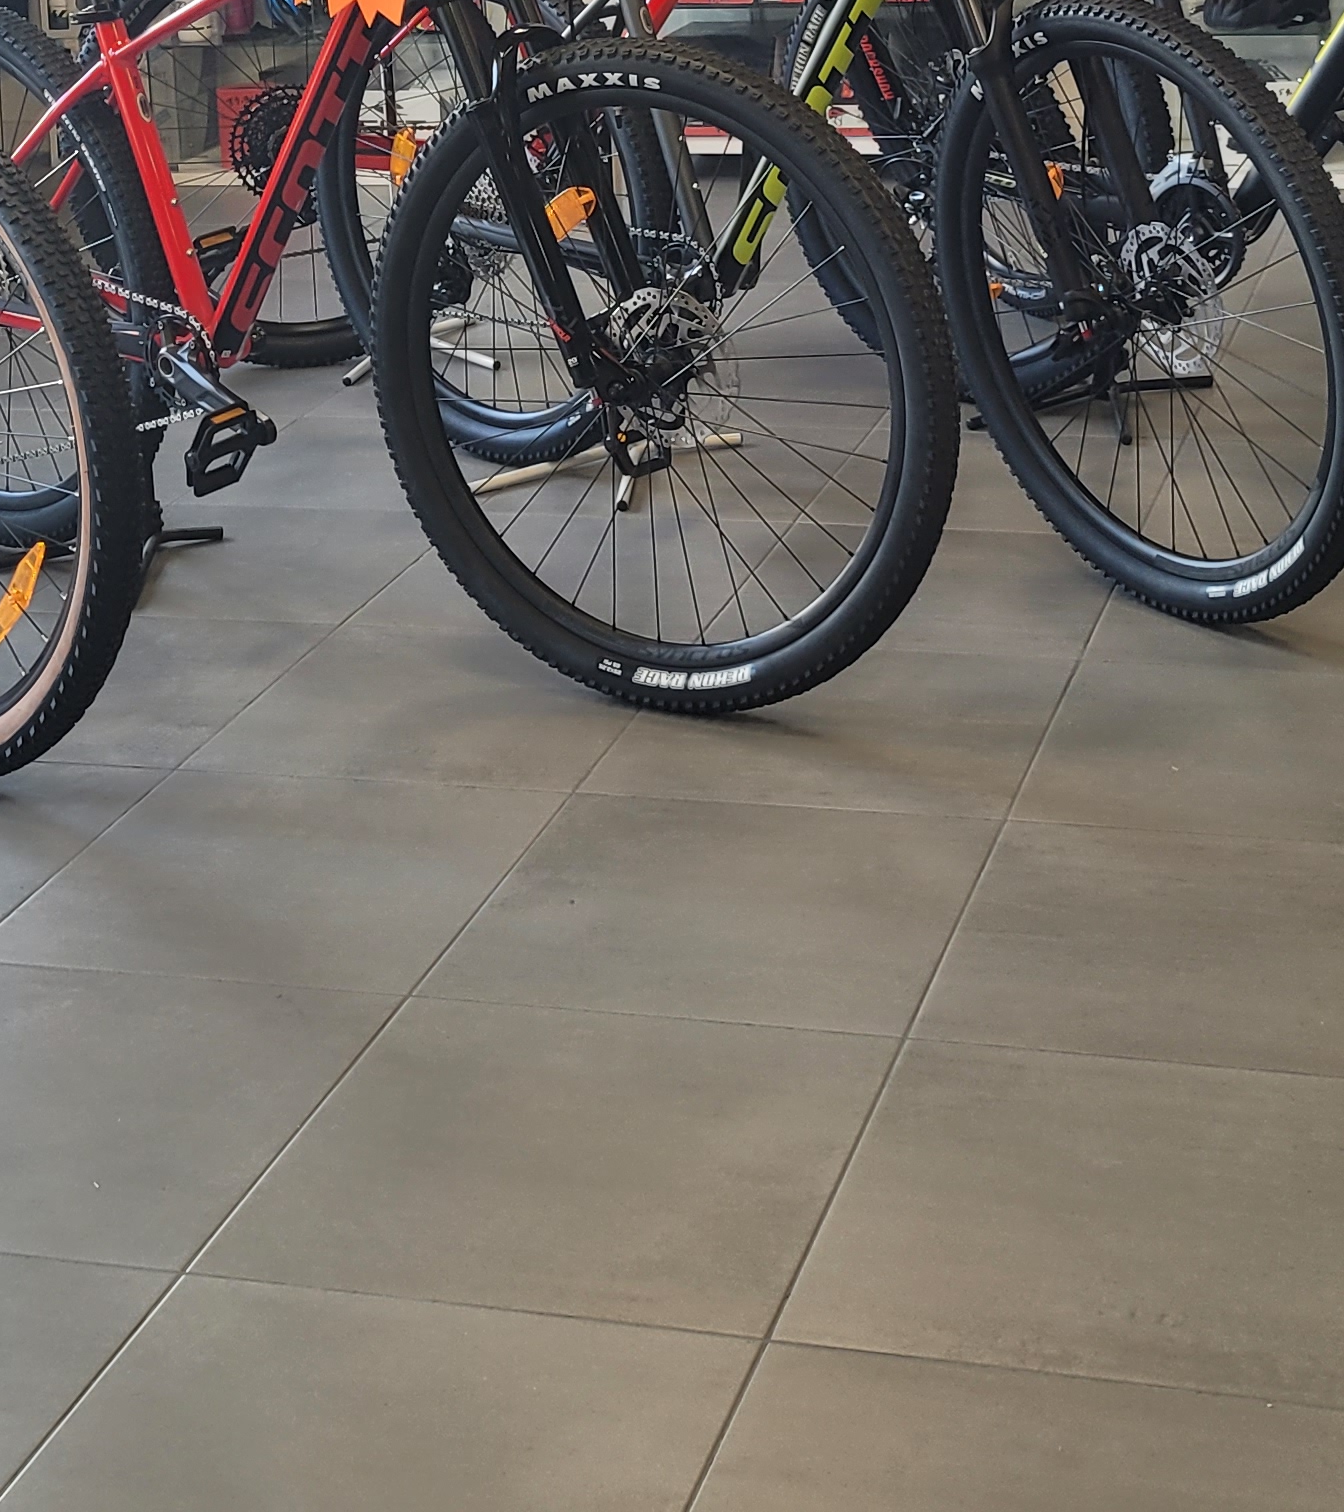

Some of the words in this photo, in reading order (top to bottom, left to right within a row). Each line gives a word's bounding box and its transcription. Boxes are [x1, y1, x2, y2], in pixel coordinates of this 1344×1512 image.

[526, 72, 662, 104] MAXXIS
[231, 14, 373, 333] SCOTT
[632, 666, 688, 690] RACE
[688, 664, 754, 690] REKON
